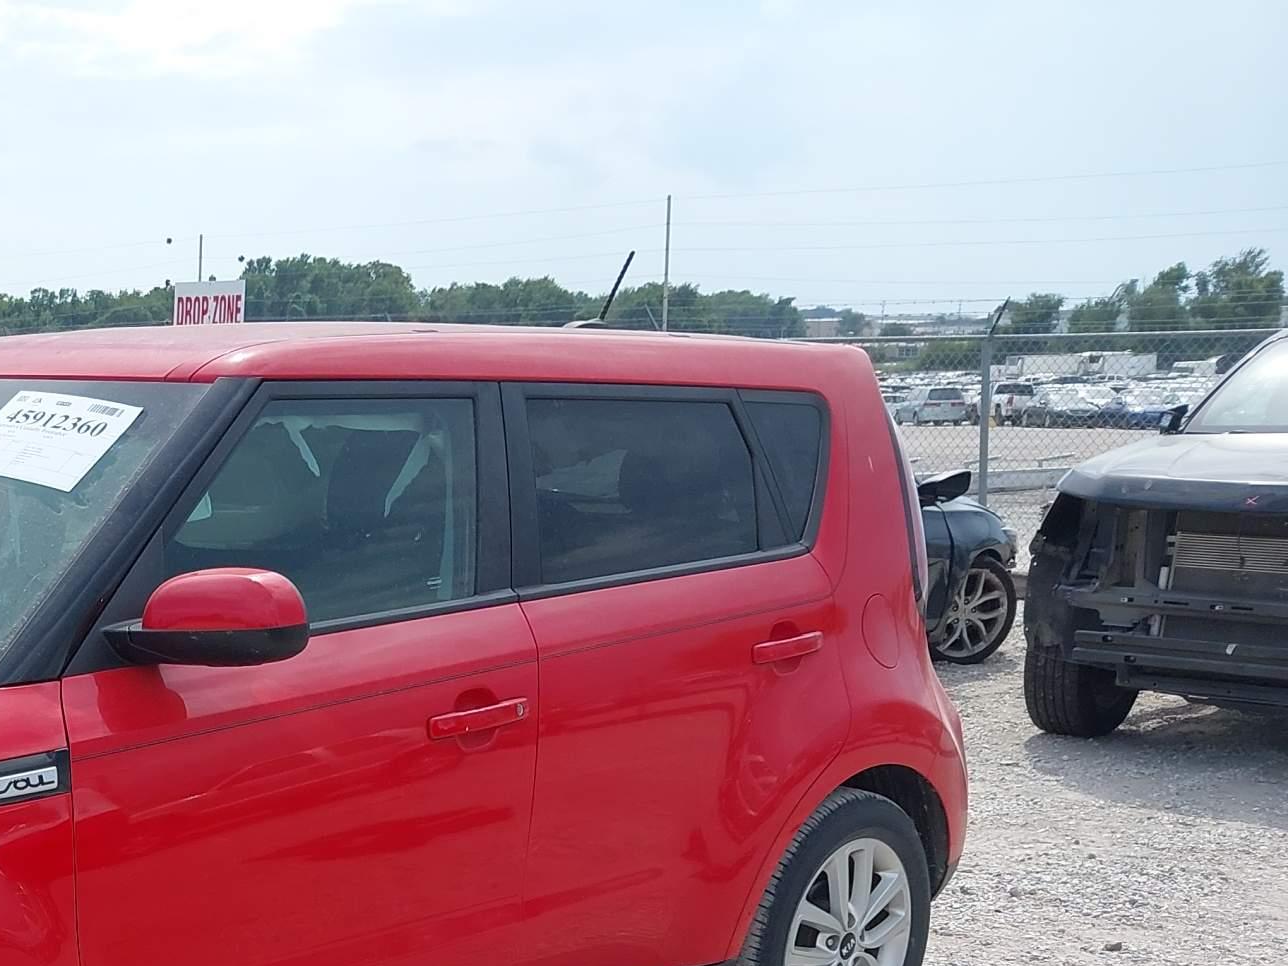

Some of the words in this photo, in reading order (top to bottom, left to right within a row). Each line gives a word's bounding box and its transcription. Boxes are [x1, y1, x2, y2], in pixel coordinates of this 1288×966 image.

[176, 296, 209, 325] DROP
[212, 294, 242, 324] ZONE
[6, 408, 108, 438] 45912360
[841, 938, 856, 956] KIA
